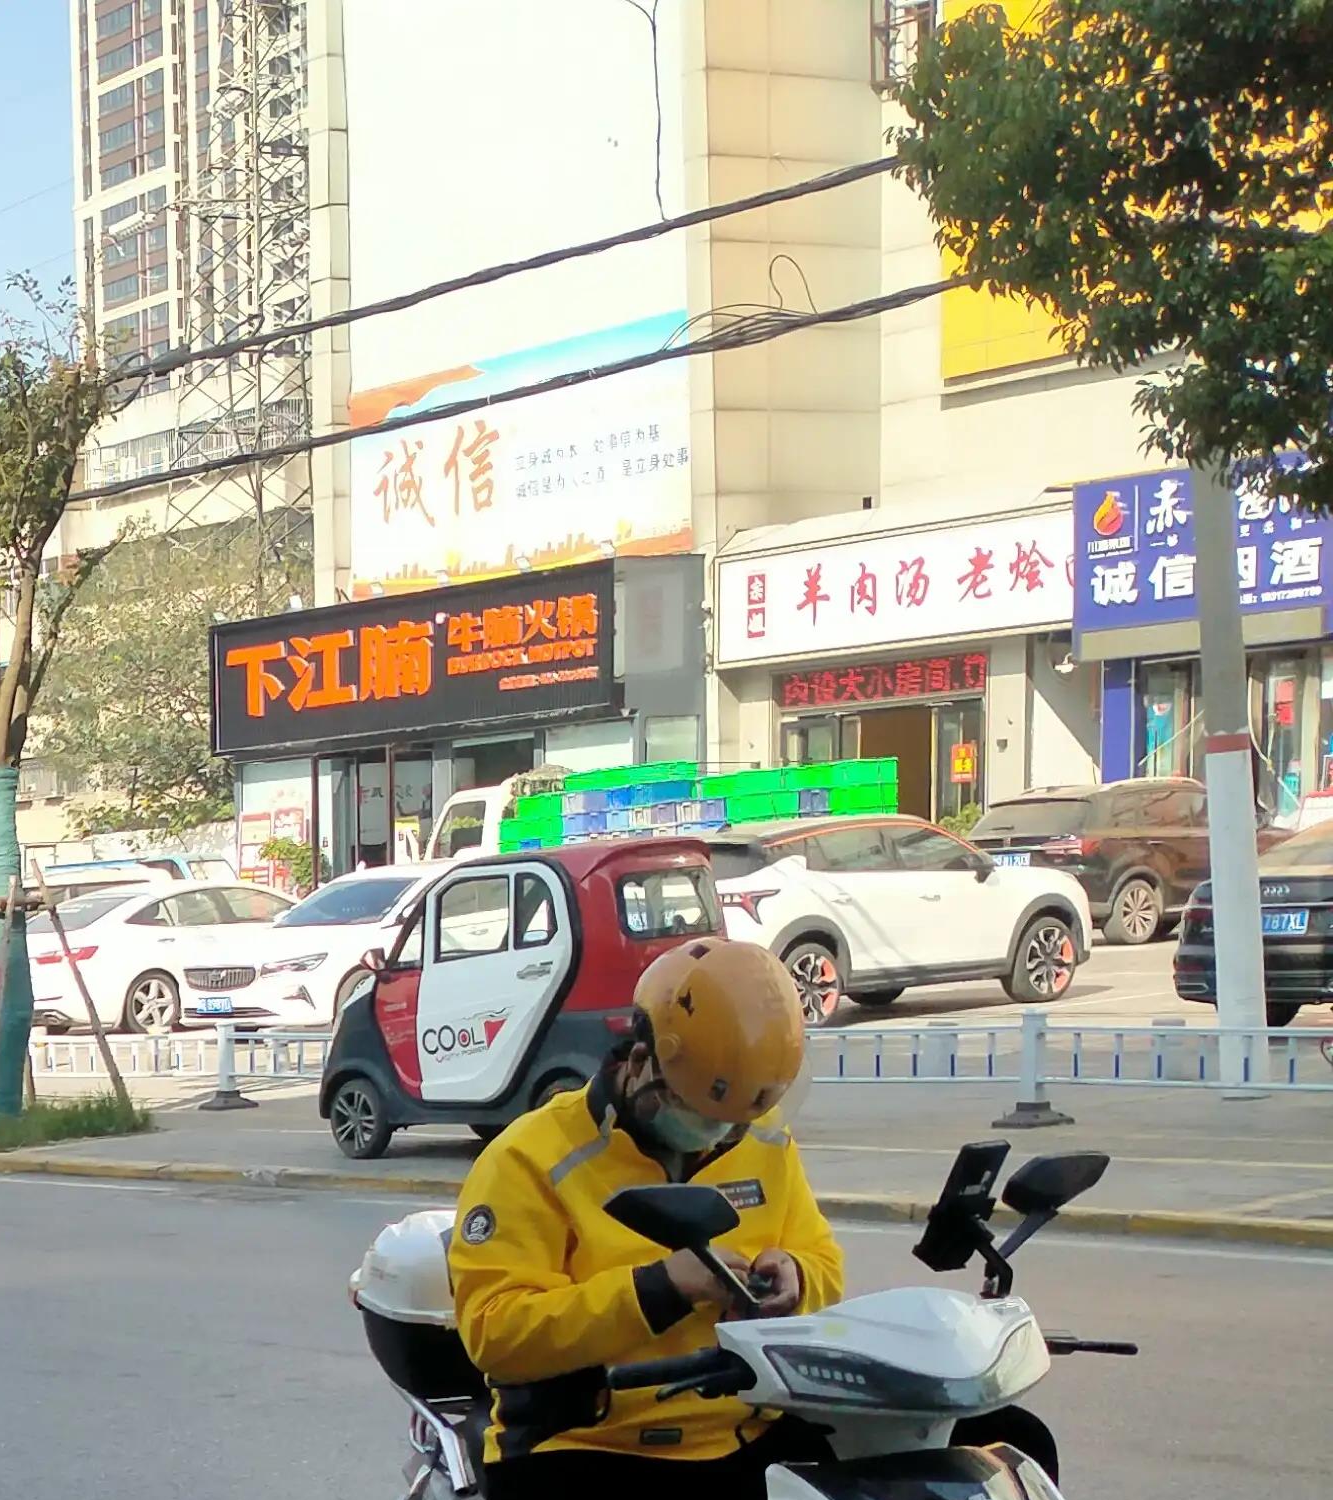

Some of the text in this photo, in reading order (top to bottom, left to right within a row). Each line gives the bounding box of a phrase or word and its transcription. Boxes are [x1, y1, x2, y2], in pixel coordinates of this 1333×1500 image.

[373, 419, 502, 528] 诚信
[957, 539, 1074, 601] 老烩
[226, 620, 434, 717] 下江腩
